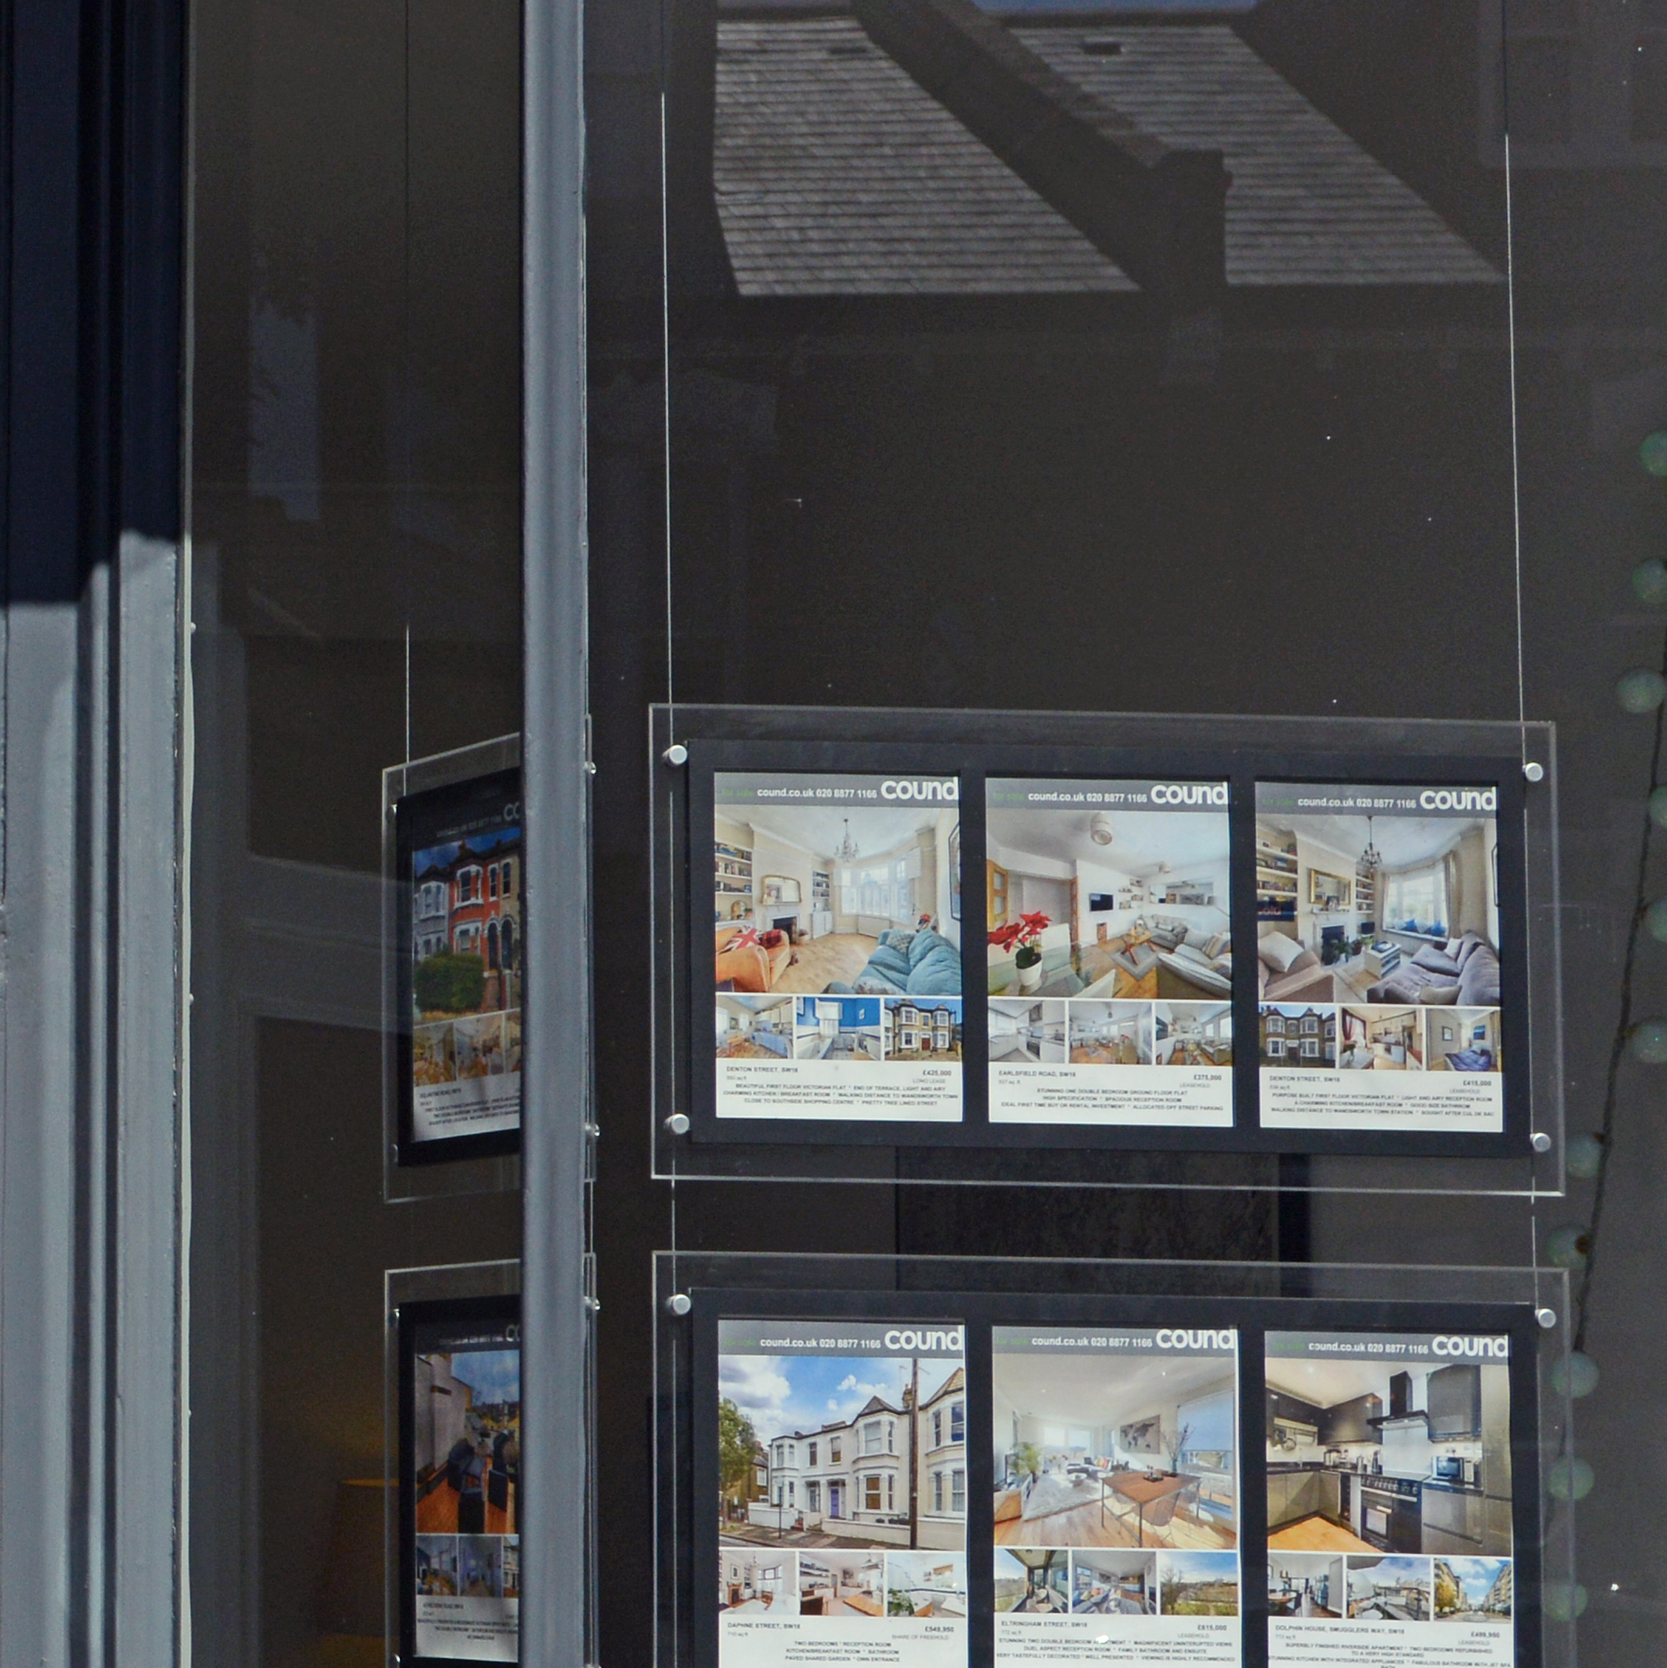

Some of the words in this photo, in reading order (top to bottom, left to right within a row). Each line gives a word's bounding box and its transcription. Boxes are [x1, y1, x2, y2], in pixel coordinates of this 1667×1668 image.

[757, 788, 814, 798] cound.co.uk
[816, 790, 832, 798] 020
[834, 790, 856, 798] 8877
[858, 790, 877, 798] 1166
[881, 777, 959, 800] cound
[1151, 782, 1228, 805] cound
[1028, 792, 1085, 802] cound.co.uk
[1087, 794, 1103, 802] 020
[1105, 794, 1126, 802] 8877
[1128, 794, 1148, 803] 1166
[1298, 797, 1355, 807] cound.co.uk
[1357, 799, 1372, 807] 020
[1374, 799, 1394, 808] 8877
[1397, 800, 1416, 808] 1166
[1420, 787, 1497, 810] cound
[760, 1338, 818, 1349] cound.co.uk
[820, 1340, 836, 1348] 020
[838, 1340, 859, 1348] 8877
[861, 1340, 881, 1349] 1166
[885, 1324, 963, 1350] cound
[1032, 1336, 1089, 1347] cound.co.uk
[1091, 1338, 1107, 1346] 020
[1109, 1338, 1129, 1346] 8877
[1132, 1339, 1152, 1347] 1166
[1156, 1329, 1235, 1349] cound
[1309, 1342, 1365, 1353] cound.co.uk
[1368, 1343, 1384, 1352] 020
[1385, 1344, 1406, 1353] 8877
[1409, 1345, 1429, 1354] 1166
[1432, 1335, 1508, 1356] cound
